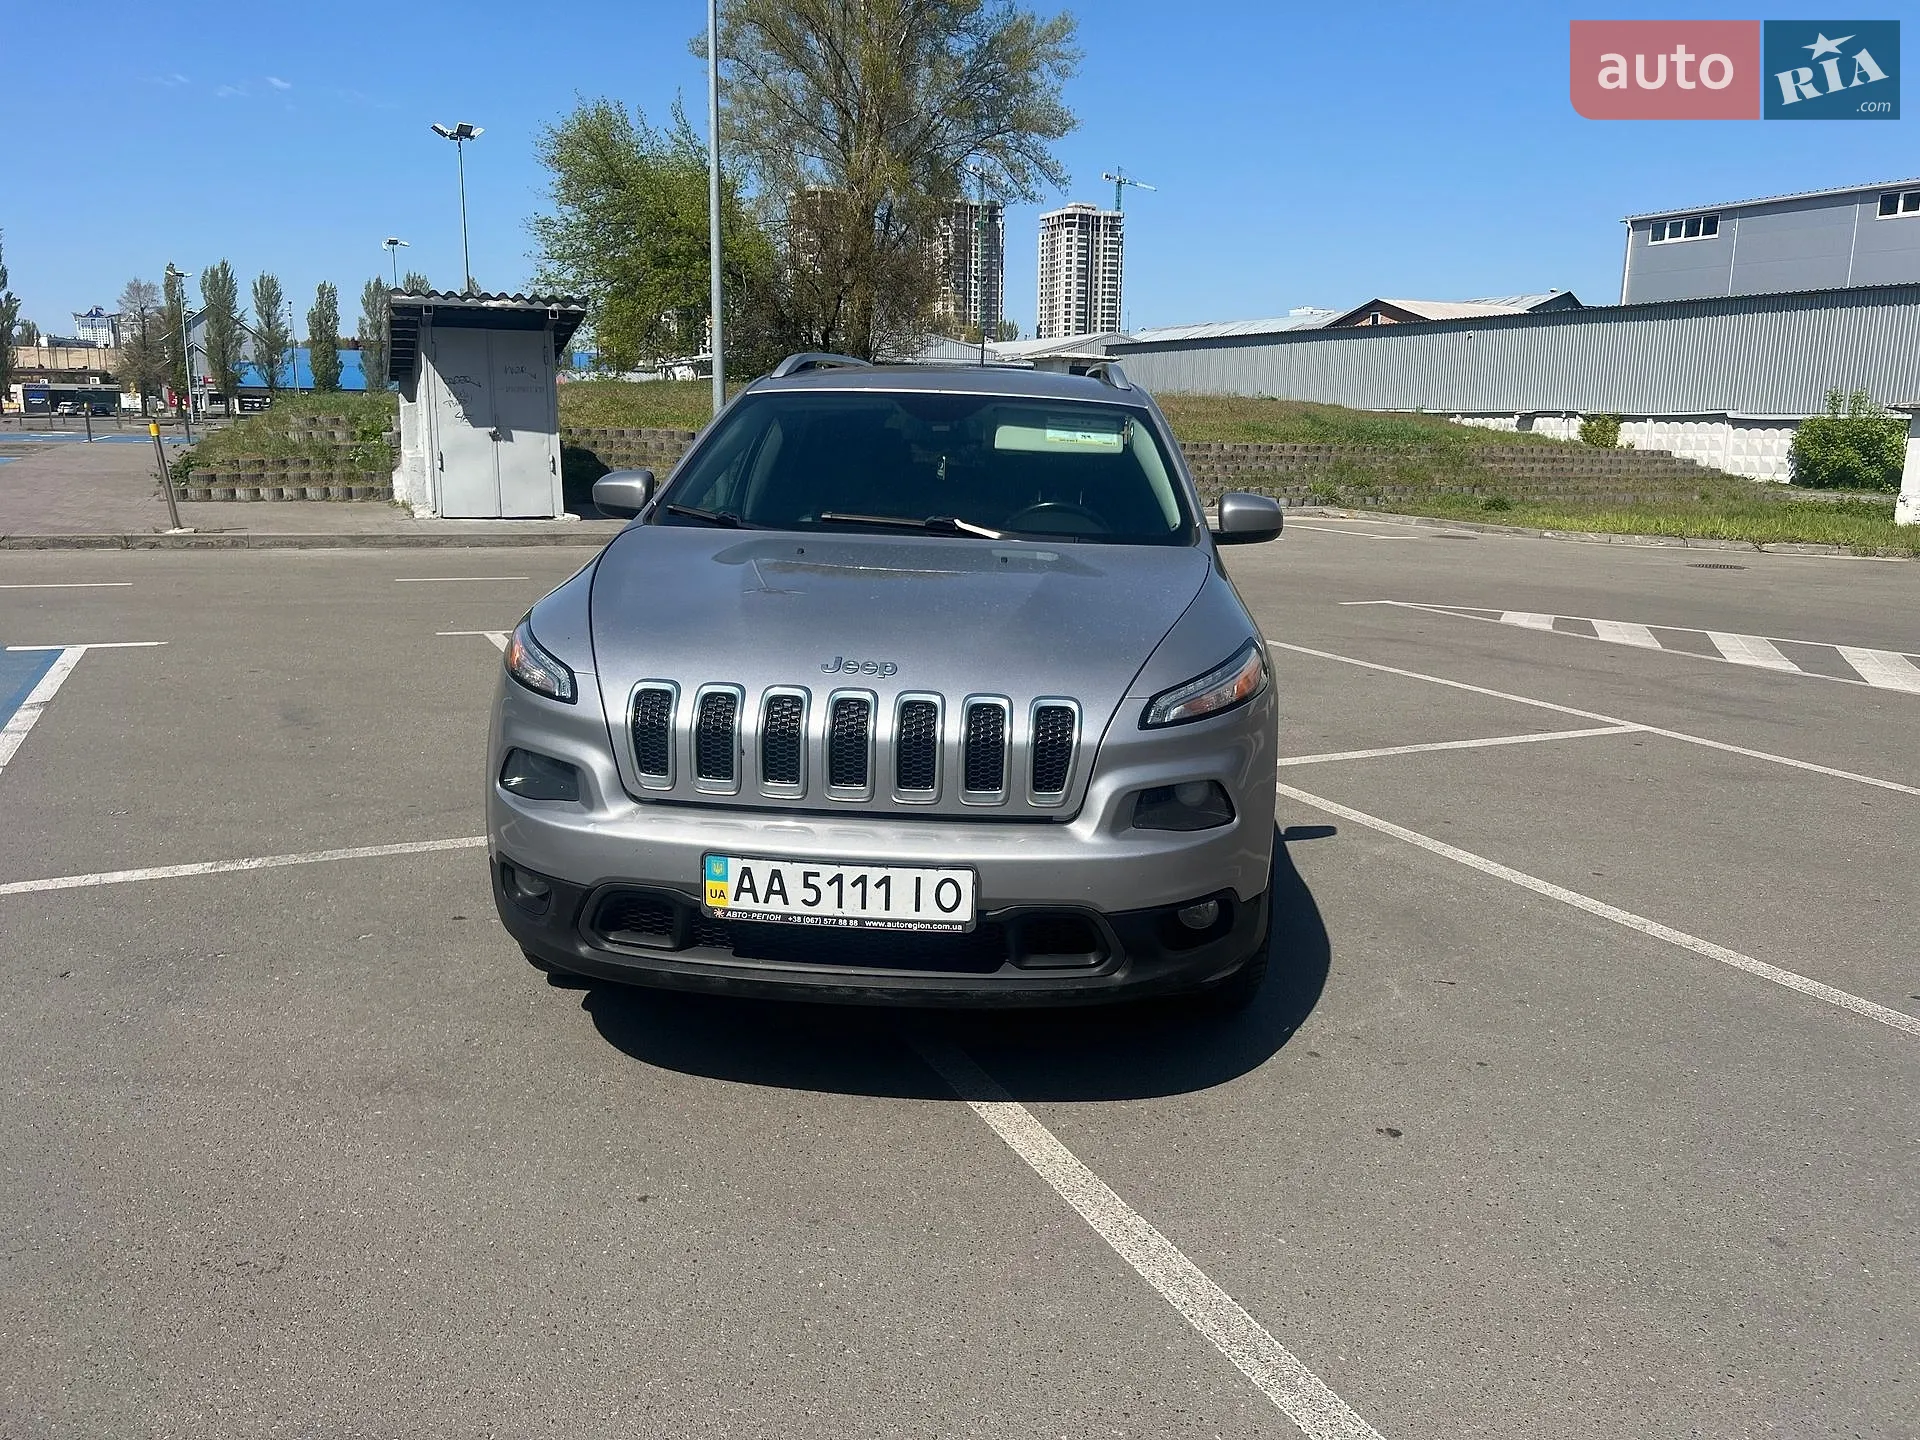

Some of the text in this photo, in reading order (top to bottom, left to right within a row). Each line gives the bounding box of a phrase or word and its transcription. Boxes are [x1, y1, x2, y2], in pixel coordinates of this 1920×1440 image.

[820, 656, 898, 679] Jeep
[709, 888, 727, 900] UA
[733, 866, 962, 913] AA 5111 IO
[725, 910, 782, 921] АВТО-РЕГІОН
[787, 916, 802, 924] +38
[803, 916, 822, 926] (067)
[865, 920, 963, 931] www.autoregion.com.ua
